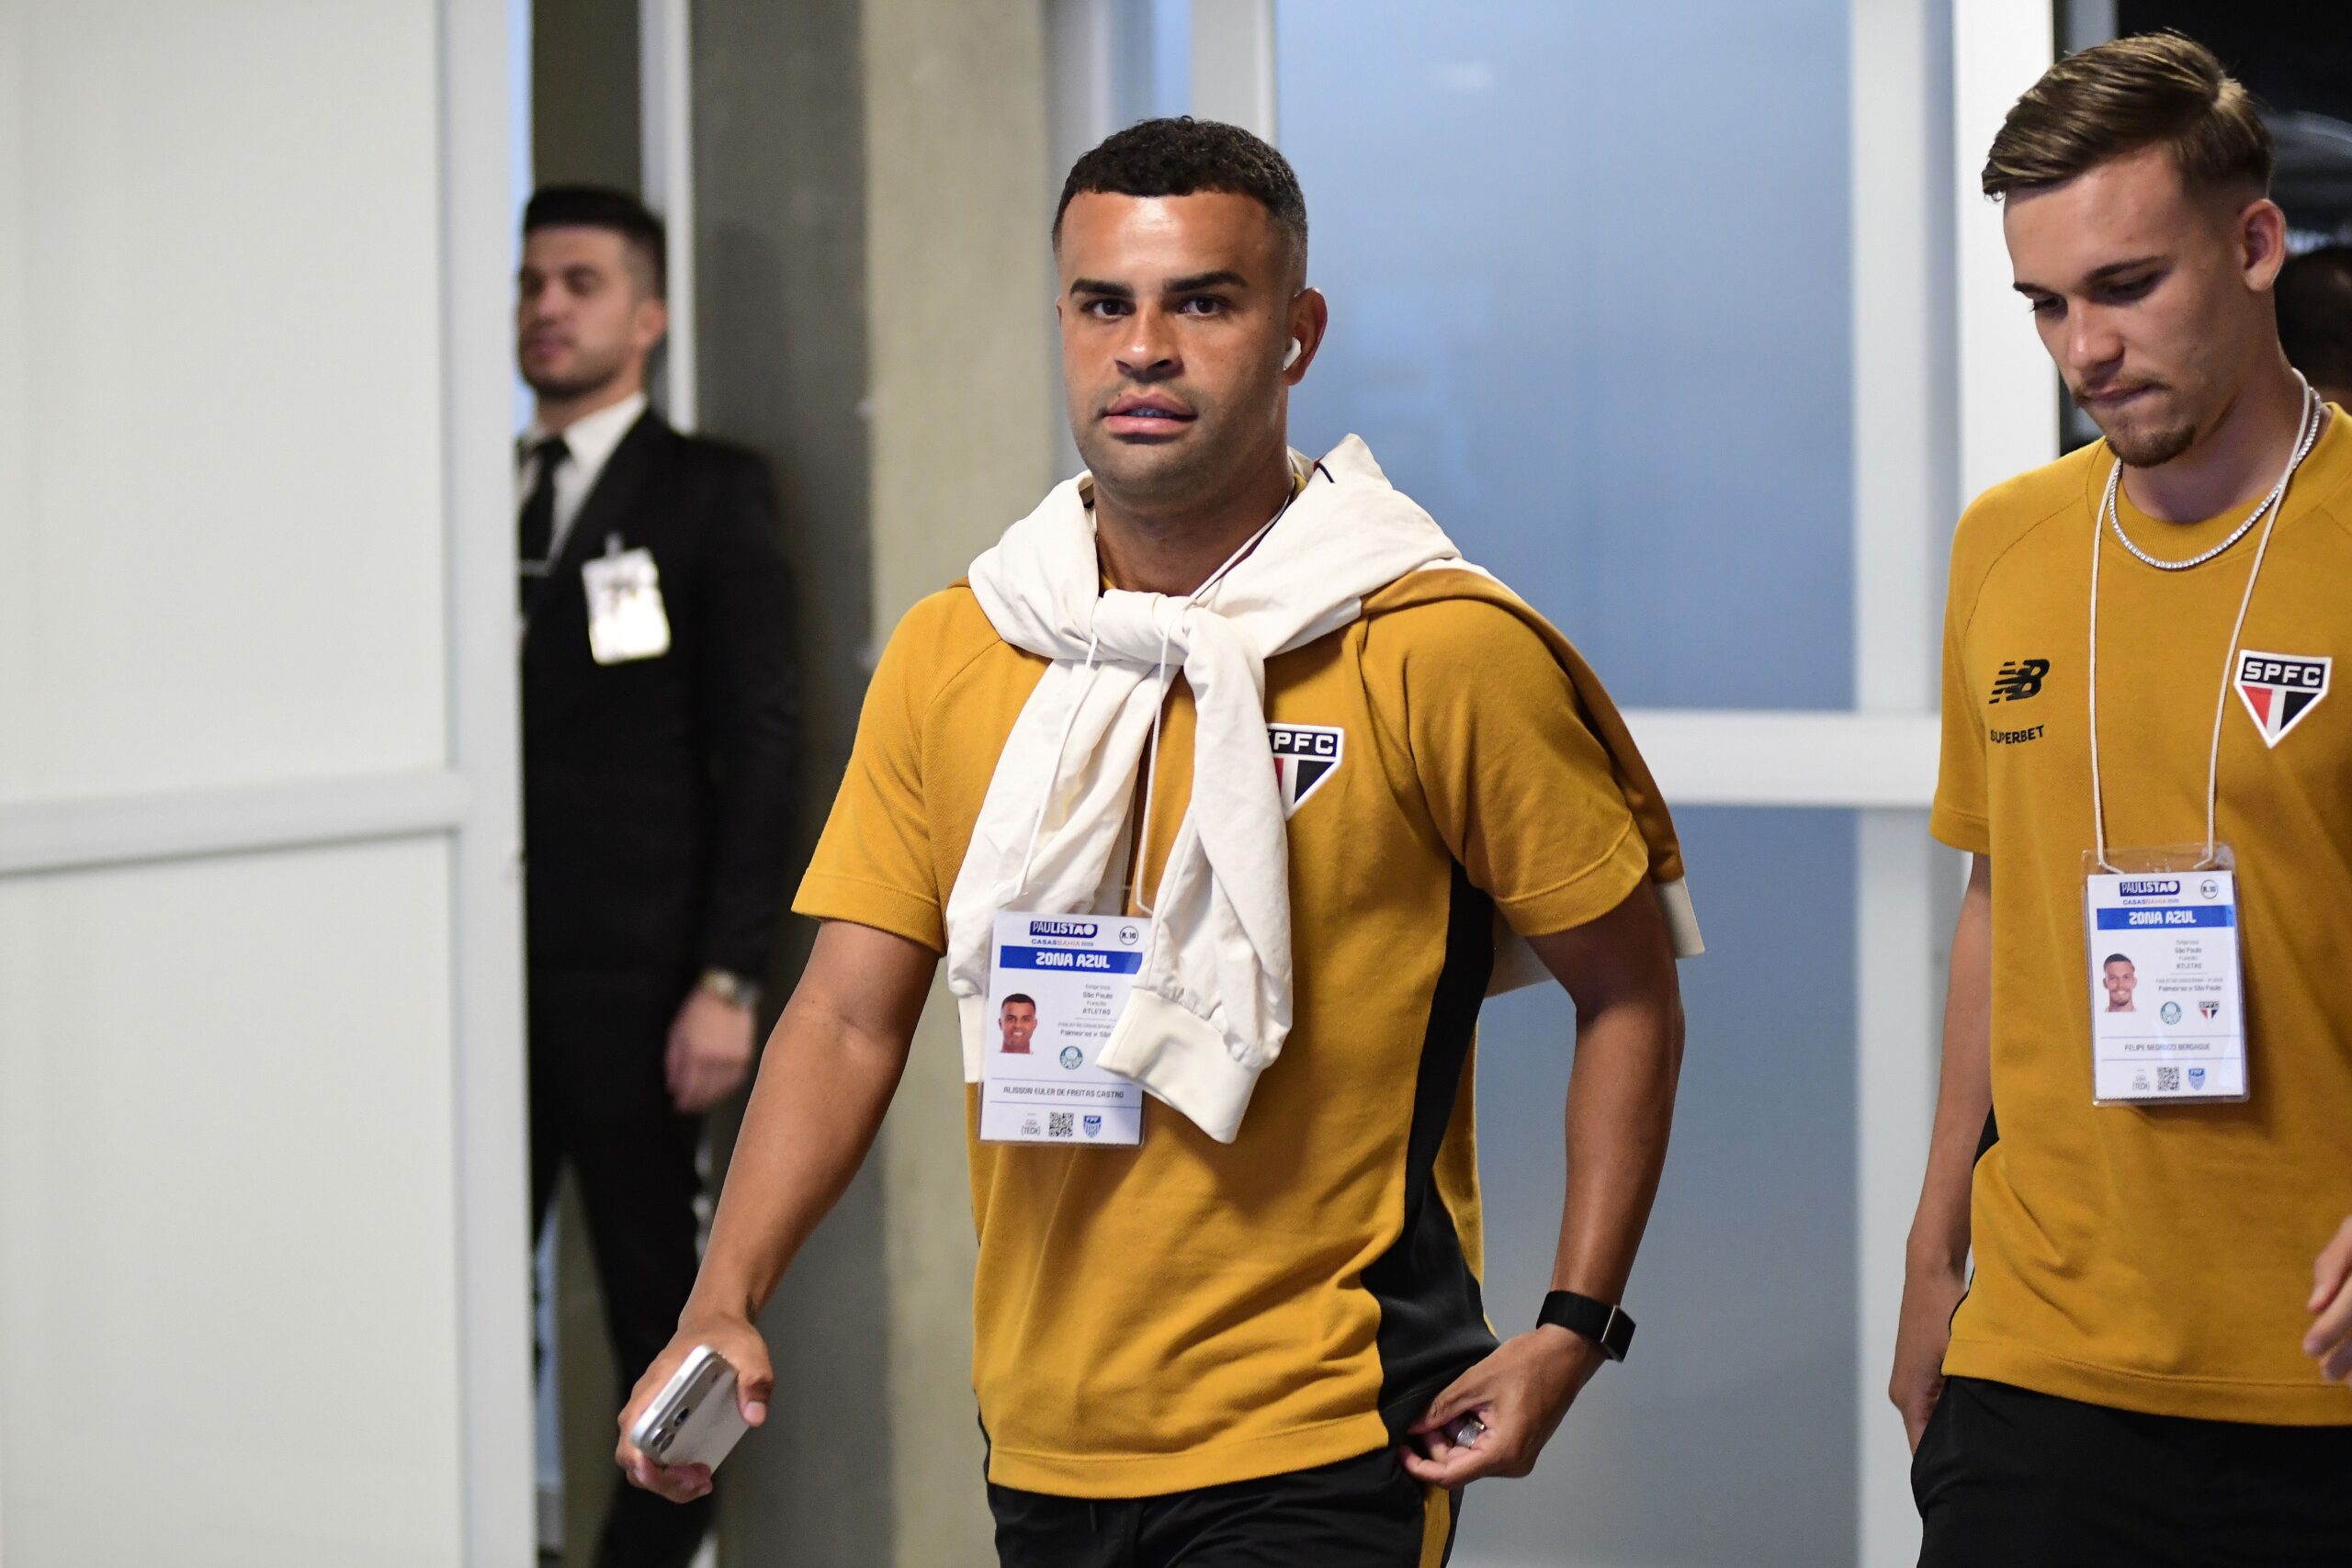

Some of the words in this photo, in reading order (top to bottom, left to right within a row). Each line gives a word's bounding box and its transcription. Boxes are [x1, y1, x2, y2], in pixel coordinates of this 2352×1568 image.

[2244, 660, 2321, 686] SPFC
[1269, 731, 1335, 754] PFC
[1990, 725, 2044, 745] SUPERBET
[2128, 911, 2164, 925] ZONA
[2165, 909, 2197, 924] AZUL
[1035, 951, 1074, 967] ZONA
[1075, 953, 1111, 969] AZUL
[2124, 1043, 2145, 1052] FELIPE
[1002, 1086, 1033, 1095] ALISSON
[1034, 1088, 1056, 1096] EULER
[1066, 1089, 1095, 1098] FREITAS
[1096, 1090, 1125, 1099] CASTRO
